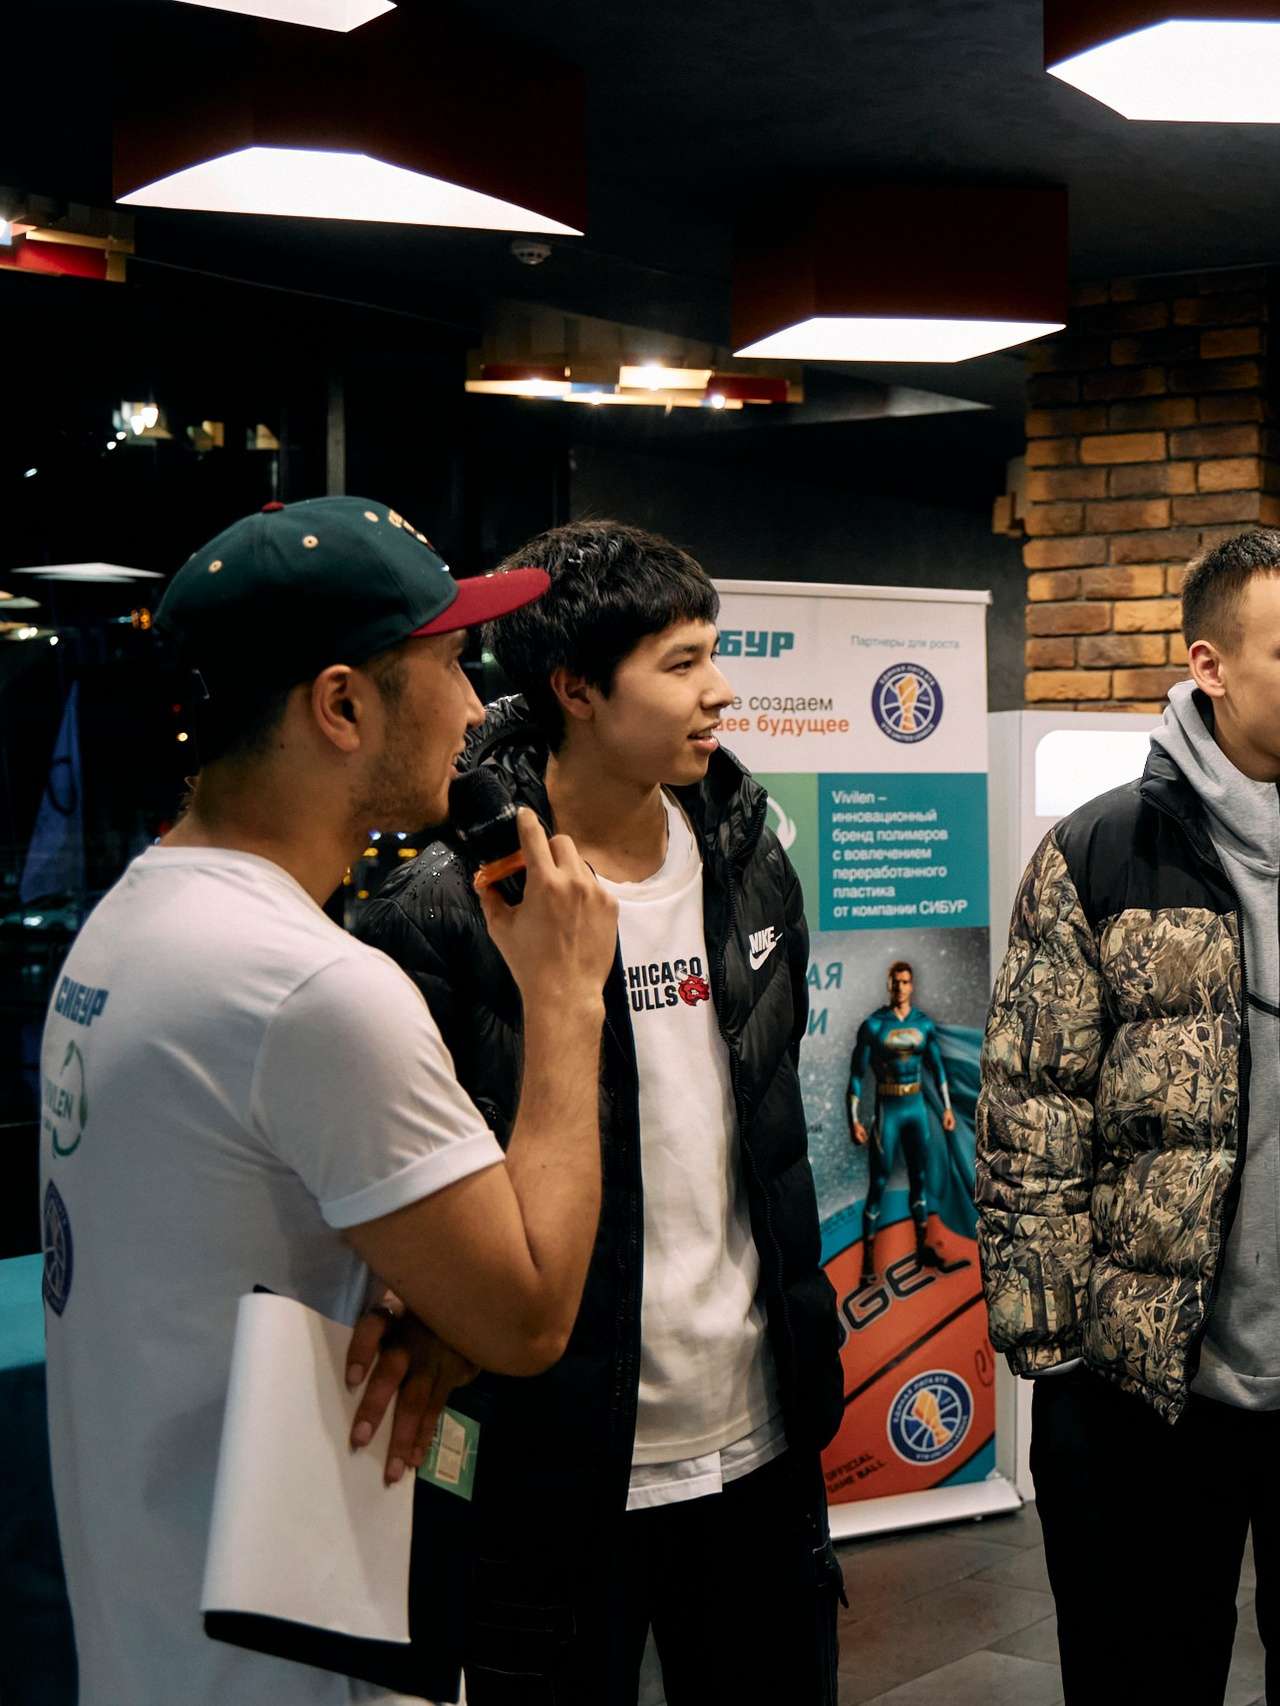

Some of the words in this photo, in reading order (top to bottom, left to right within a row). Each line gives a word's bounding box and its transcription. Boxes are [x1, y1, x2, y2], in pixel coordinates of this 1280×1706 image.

[717, 630, 794, 658] БУР
[929, 640, 959, 650] роста
[749, 697, 833, 713] создаем
[757, 714, 850, 737] будущее
[832, 790, 875, 804] Vivilen
[832, 809, 937, 824] инновационный
[832, 829, 874, 844] бренд
[877, 829, 949, 843] полимеров
[832, 850, 842, 861] с
[844, 848, 932, 861] вовлечением
[833, 865, 948, 882] переработанного
[833, 886, 896, 898] пластика
[833, 906, 849, 917] от
[852, 904, 917, 917] компании
[919, 899, 968, 915] СИБУР
[748, 925, 776, 954] NIKE
[624, 956, 703, 989] HICAGO
[807, 962, 843, 990] АЯ
[629, 984, 679, 1012] ULLS
[839, 1252, 973, 1334] GEL
[826, 1453, 874, 1481] OFFICIAL
[856, 1460, 886, 1479] BALL
